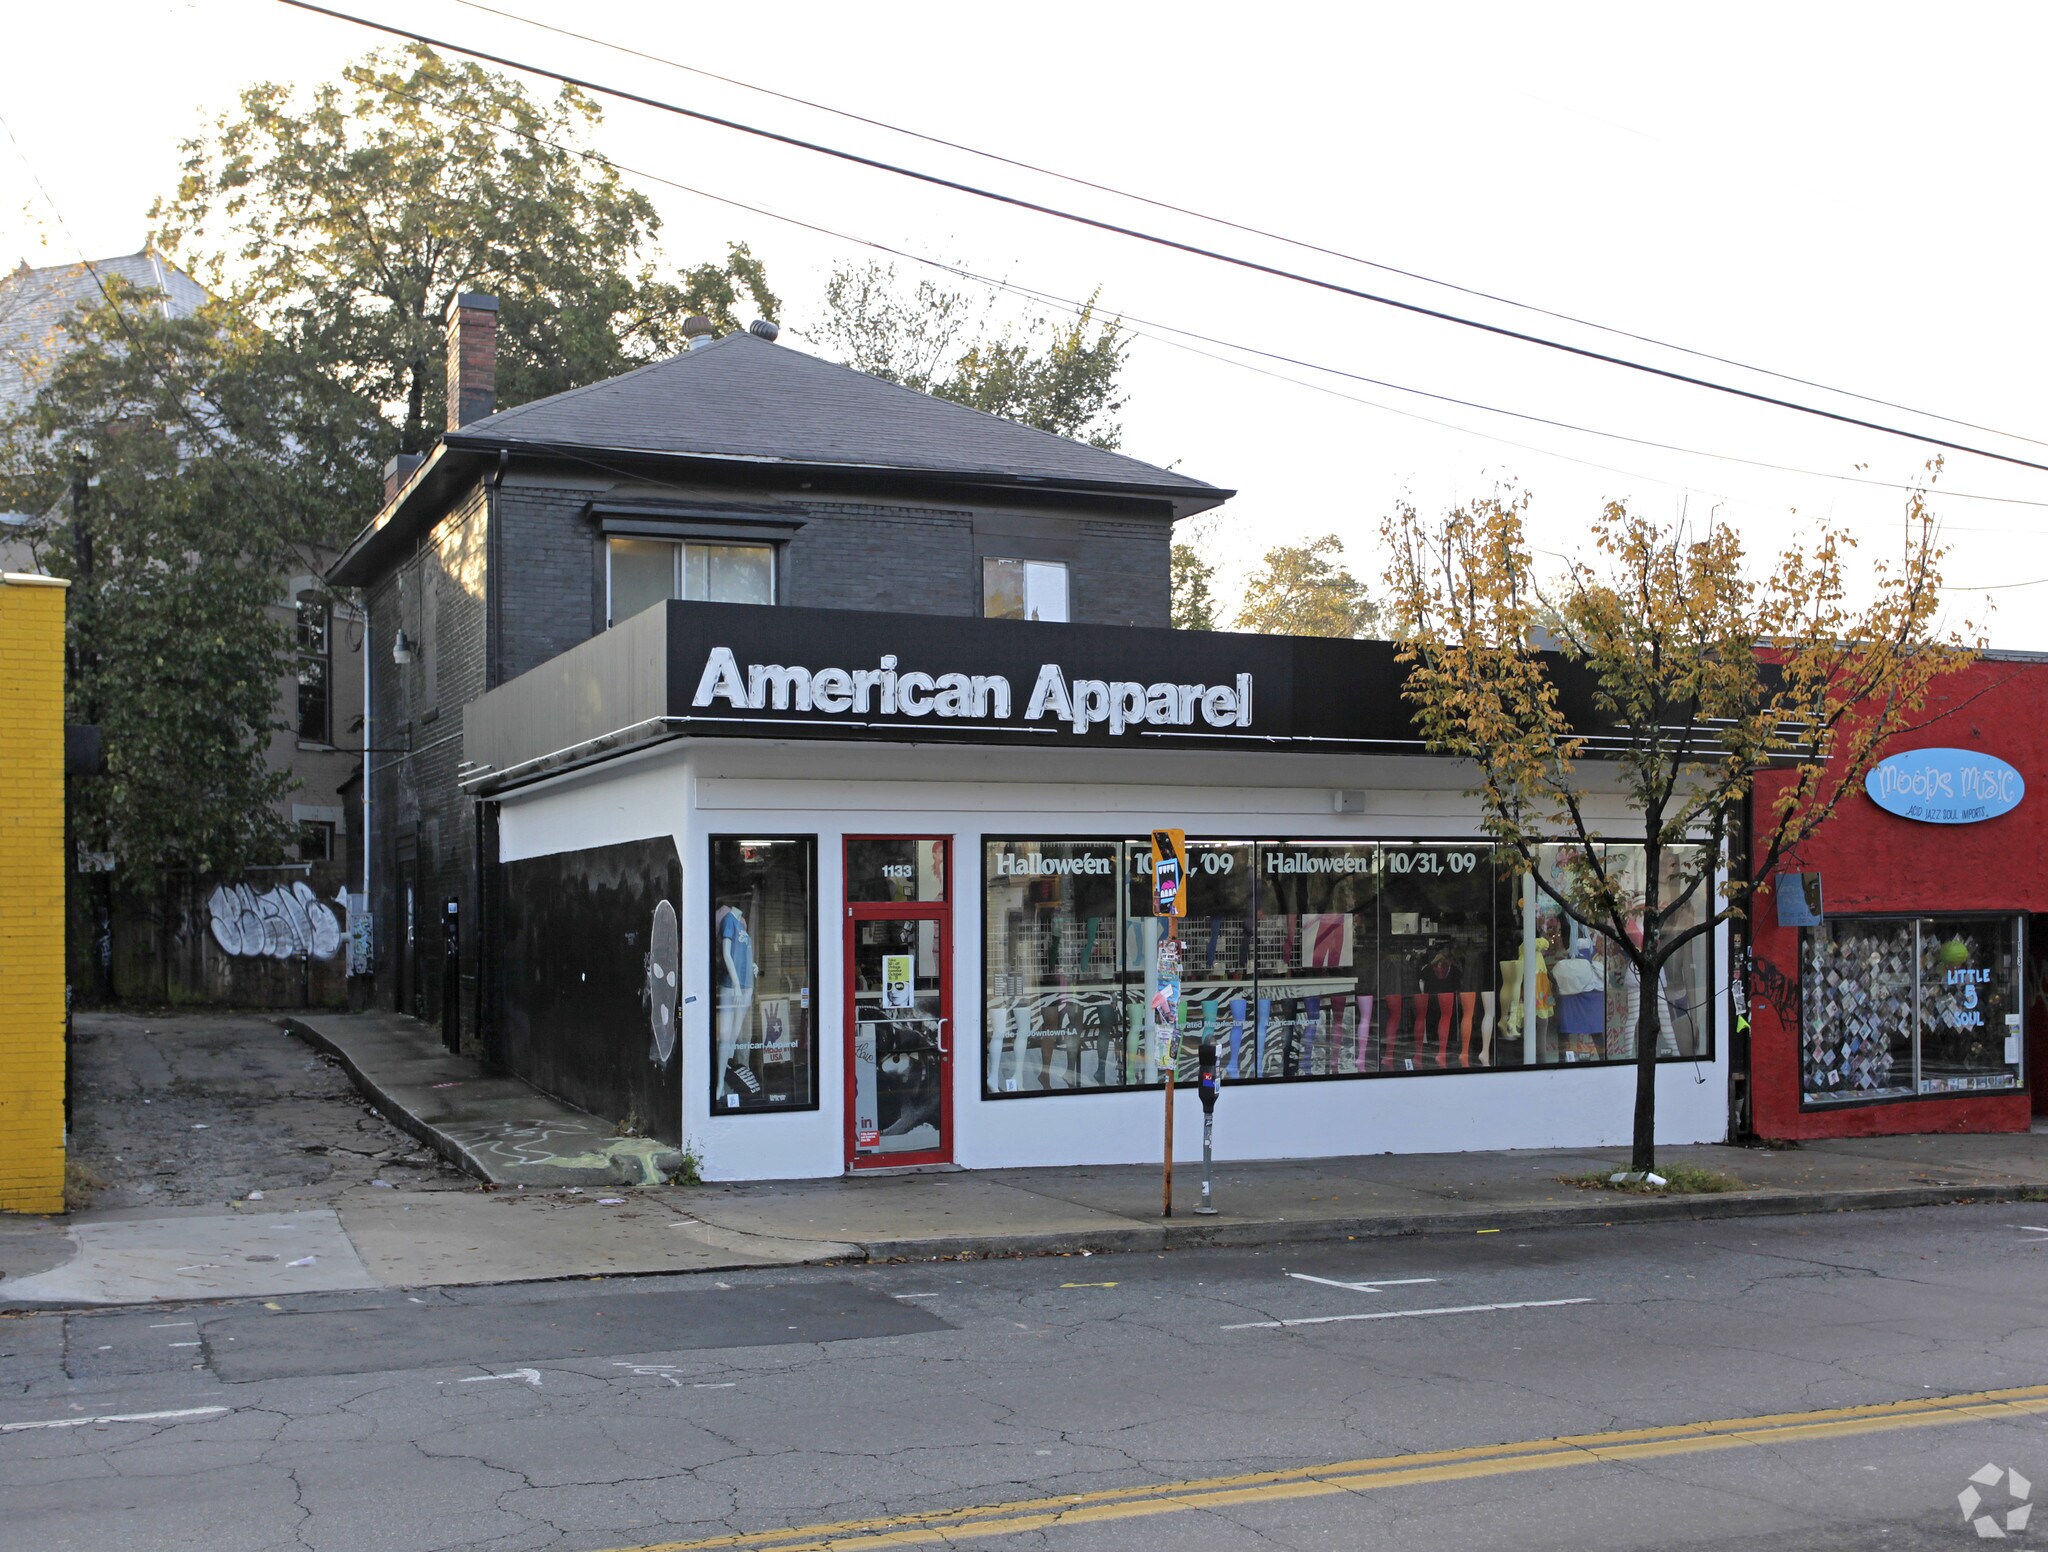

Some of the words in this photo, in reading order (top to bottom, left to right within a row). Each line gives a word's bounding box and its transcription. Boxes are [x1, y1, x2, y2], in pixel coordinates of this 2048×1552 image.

[692, 646, 1011, 719] American
[1023, 663, 1252, 735] Apparel
[1906, 805, 1923, 817] ACID
[1925, 808, 1941, 820] JAZZ
[1943, 808, 1958, 820] SOUL
[1961, 805, 1985, 820] IMPORTS
[882, 865, 912, 878] 1133
[1388, 852, 1444, 876] 10/31,
[1947, 968, 1990, 986] LITTLE
[1963, 984, 1978, 1009] 5
[1953, 1010, 1985, 1027] SOUL
[1067, 1027, 1078, 1036] LA
[770, 1053, 783, 1062] USA
[861, 1116, 872, 1129] in
